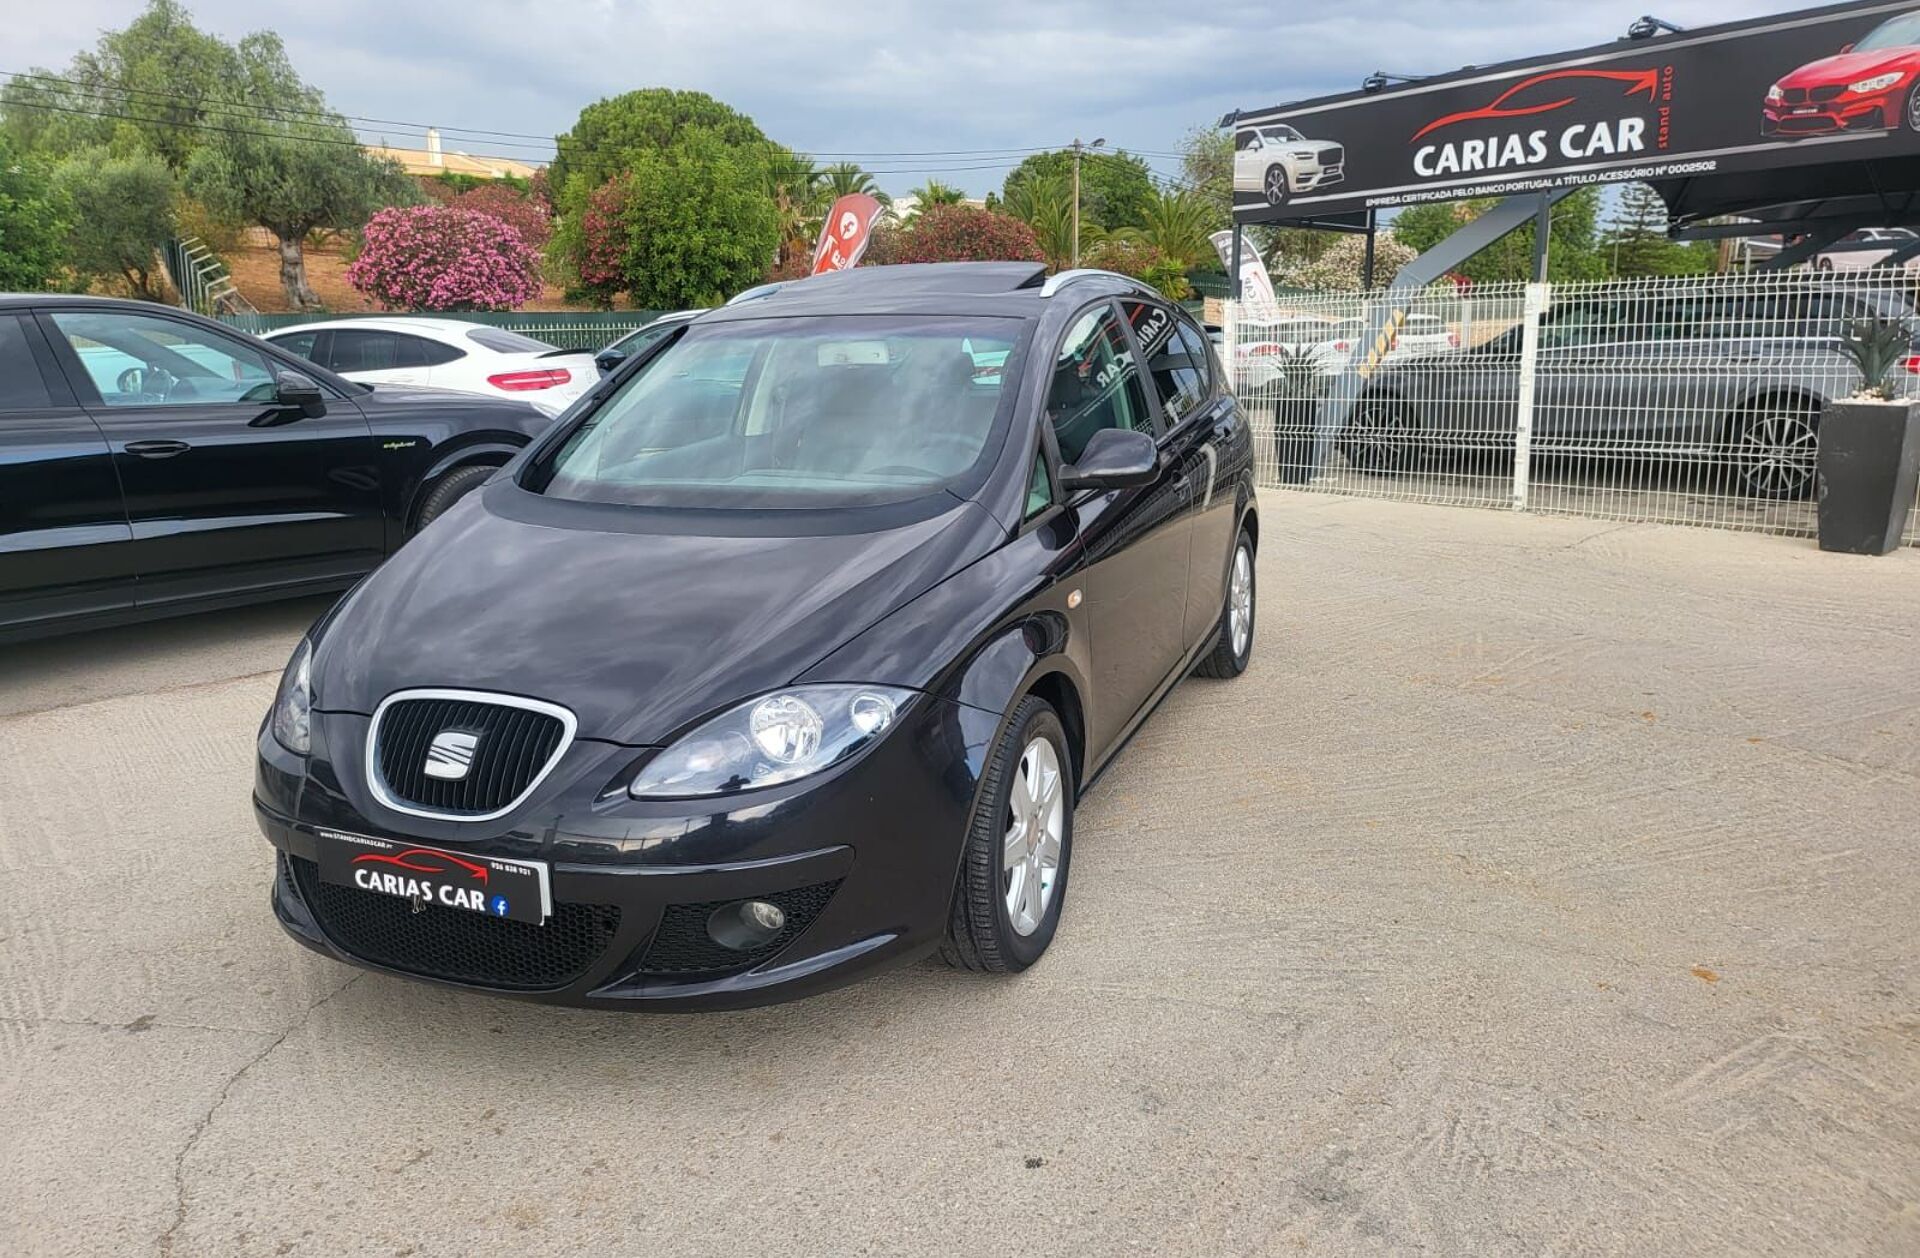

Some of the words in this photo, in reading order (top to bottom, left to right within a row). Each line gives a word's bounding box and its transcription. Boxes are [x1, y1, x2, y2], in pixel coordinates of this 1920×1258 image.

[1662, 66, 1674, 101] auto
[1413, 130, 1548, 176] CARIAS
[1559, 117, 1646, 159] CAR
[1657, 106, 1670, 149] stand
[1366, 196, 1401, 207] EMPRESA
[1402, 189, 1452, 203] CERTIFICADA
[1453, 187, 1474, 197] PELO
[1475, 183, 1506, 195] BANCO
[1506, 177, 1553, 191] PORTUGAL
[1554, 177, 1563, 186] A
[1563, 173, 1597, 186] TÍTULO
[1598, 167, 1654, 182] ACESSÓRIO
[1668, 160, 1717, 174] 0002502
[354, 868, 433, 901] CARIAS
[438, 885, 486, 911] CAR
